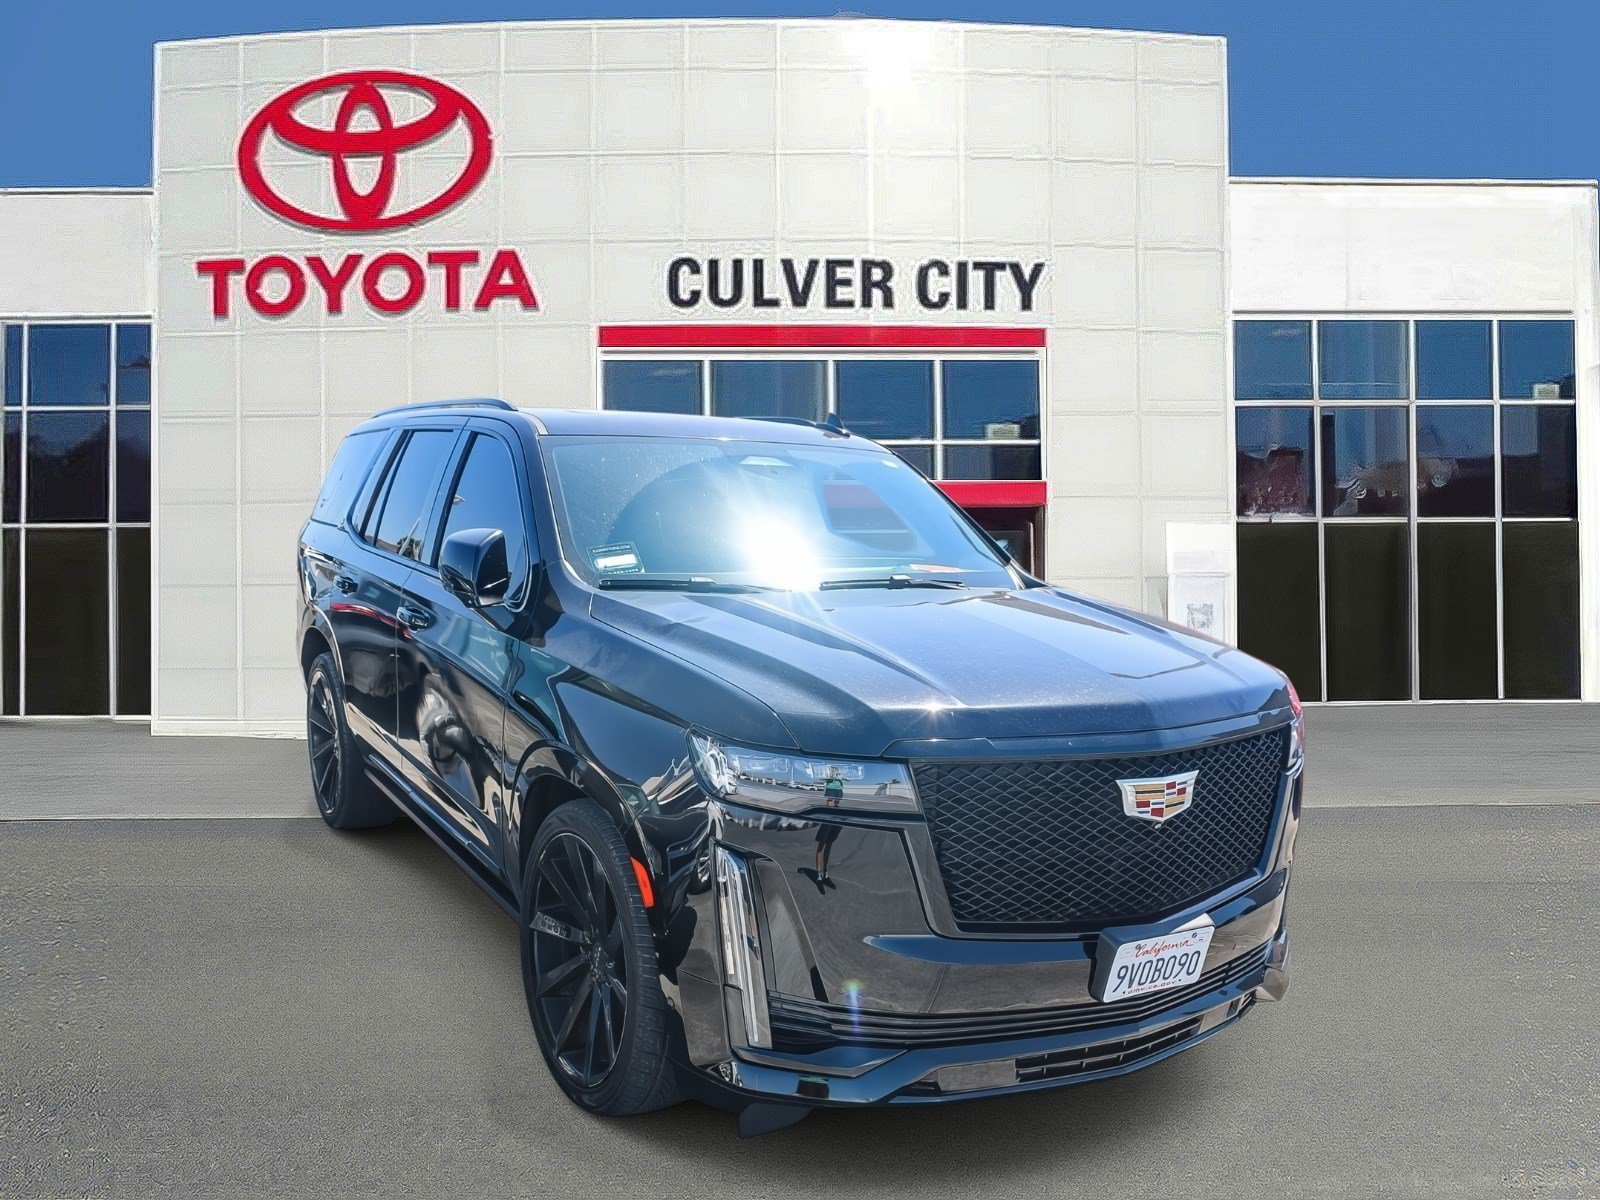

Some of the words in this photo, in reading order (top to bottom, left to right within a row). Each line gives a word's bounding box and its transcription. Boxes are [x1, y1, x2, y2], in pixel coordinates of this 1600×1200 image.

[197, 250, 538, 317] TOYOTA
[668, 256, 895, 309] CULVER
[916, 259, 1045, 311] CITY
[1135, 938, 1194, 958] California
